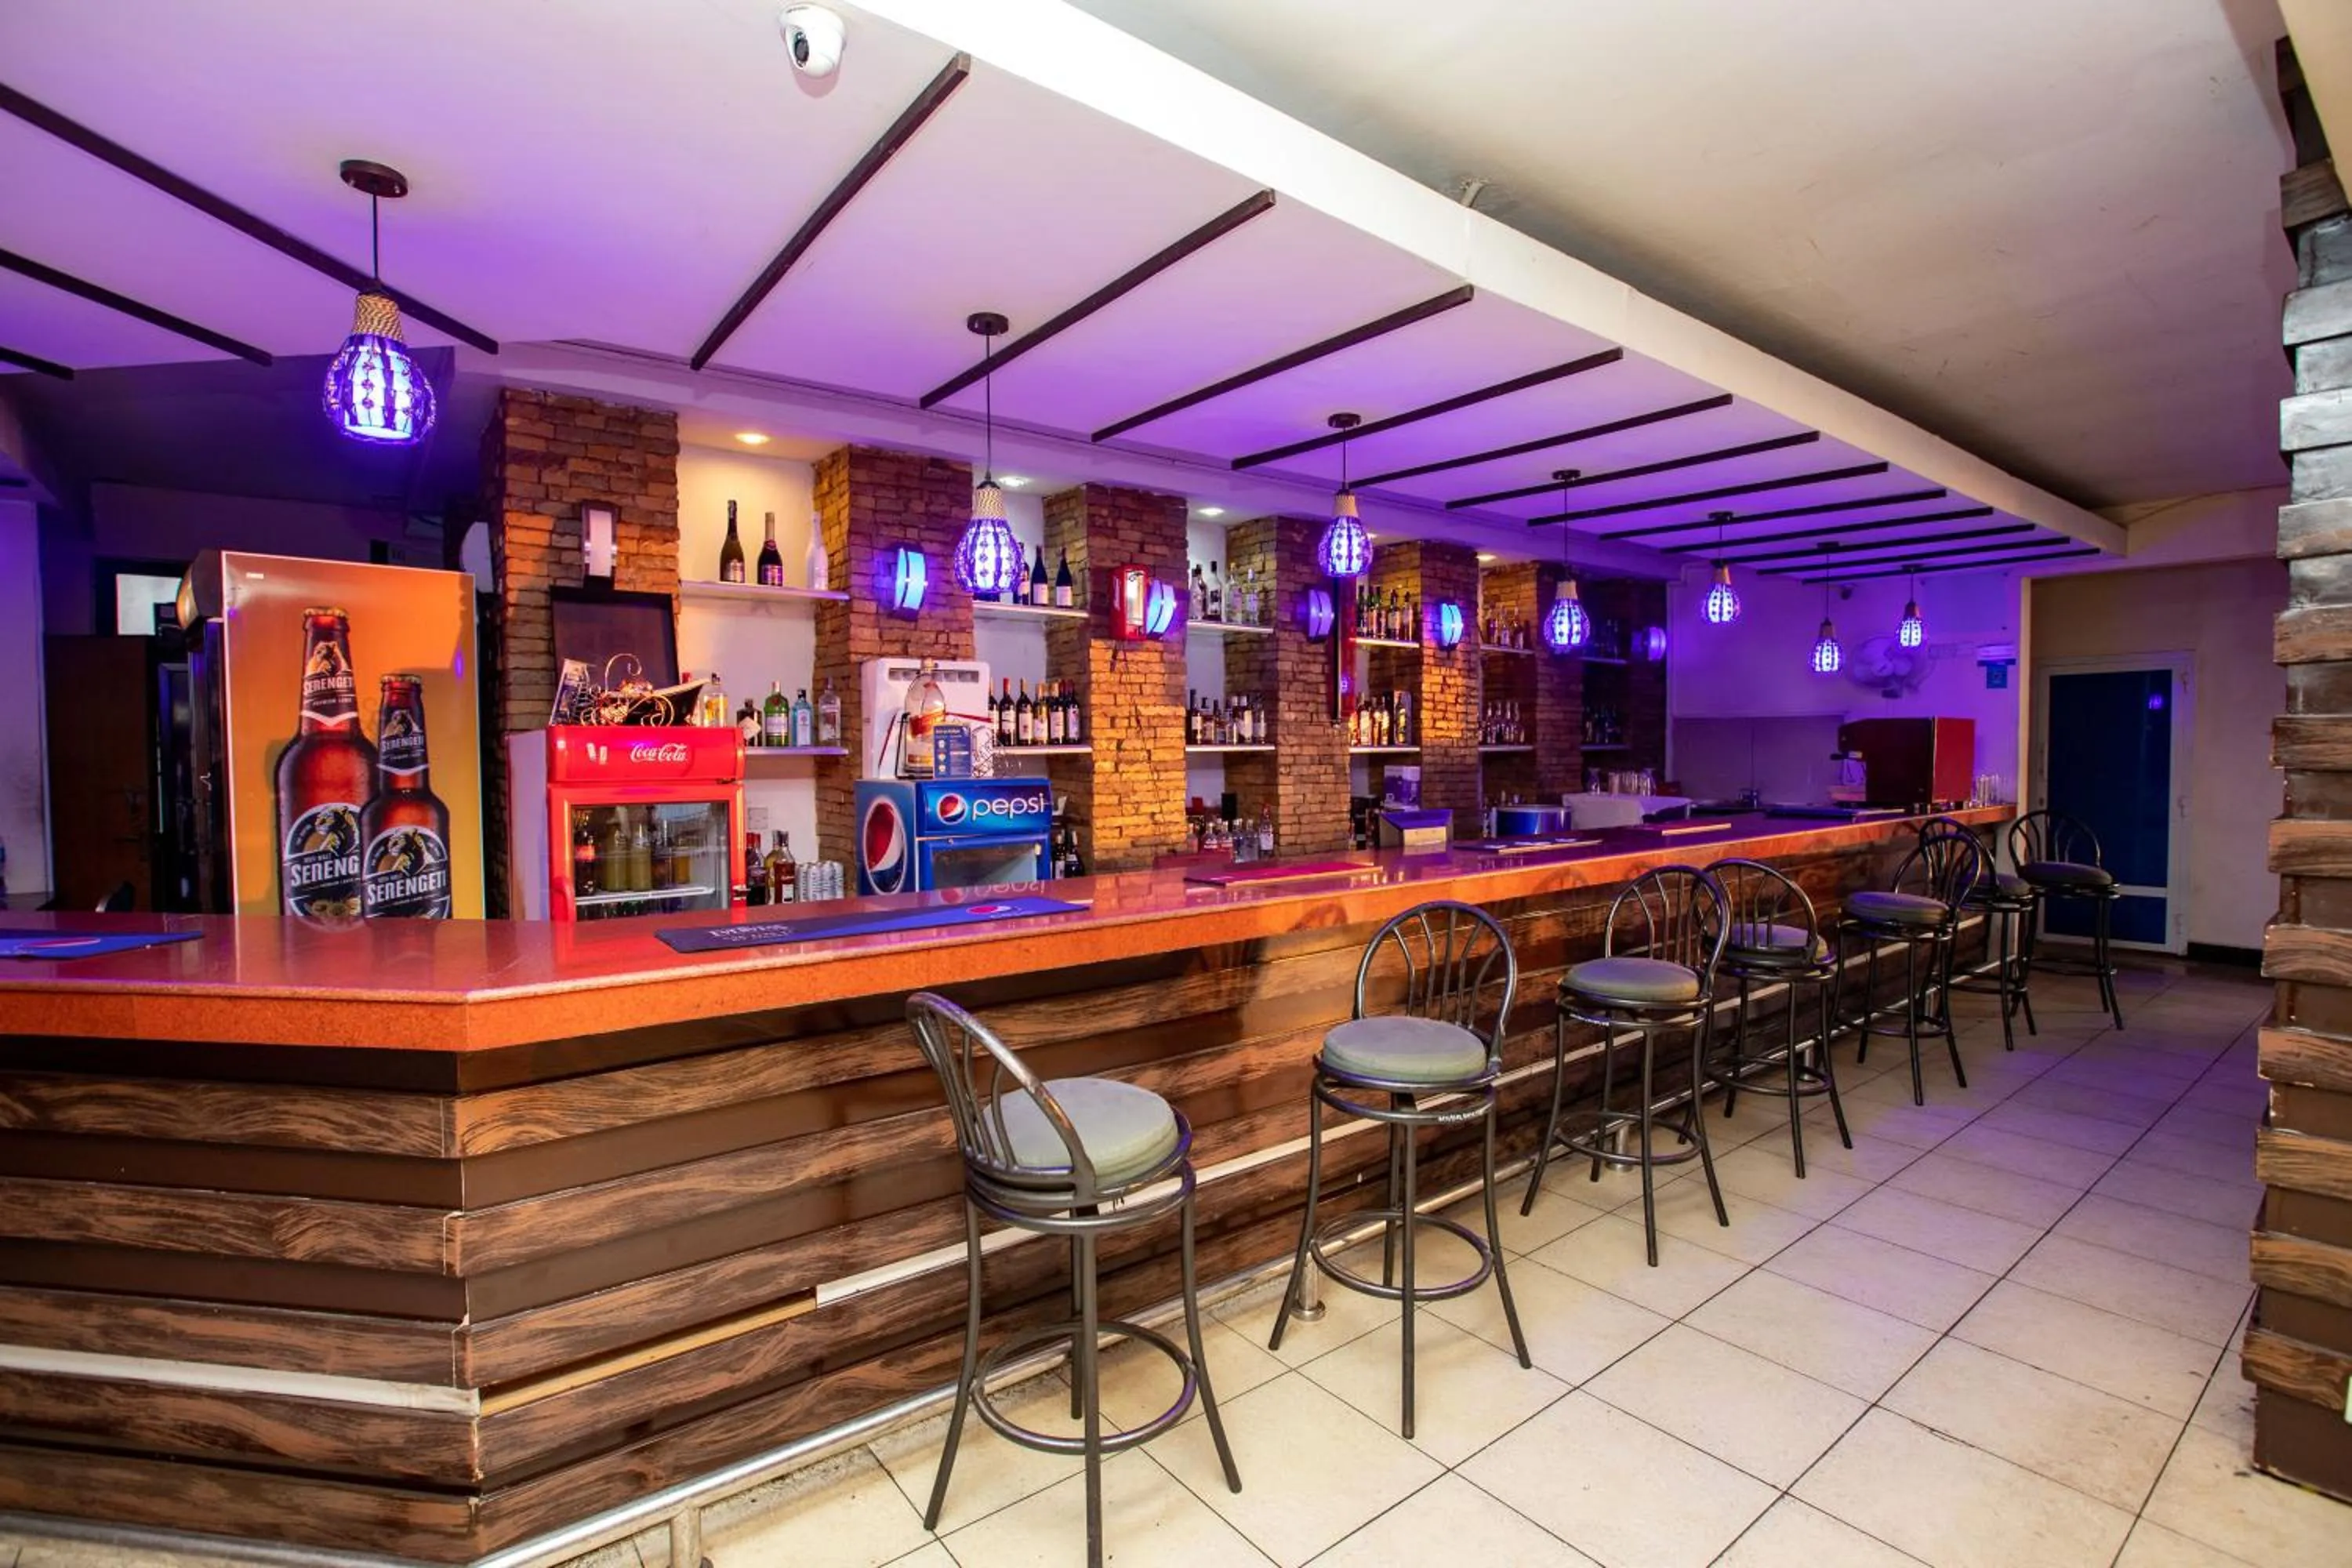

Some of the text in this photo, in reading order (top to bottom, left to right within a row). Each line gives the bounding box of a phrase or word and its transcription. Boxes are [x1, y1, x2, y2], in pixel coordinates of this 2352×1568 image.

[303, 677, 352, 695] SERENGET
[972, 793, 1044, 822] pepsi
[291, 855, 360, 887] SERENG
[367, 870, 447, 905] SERENGETI
